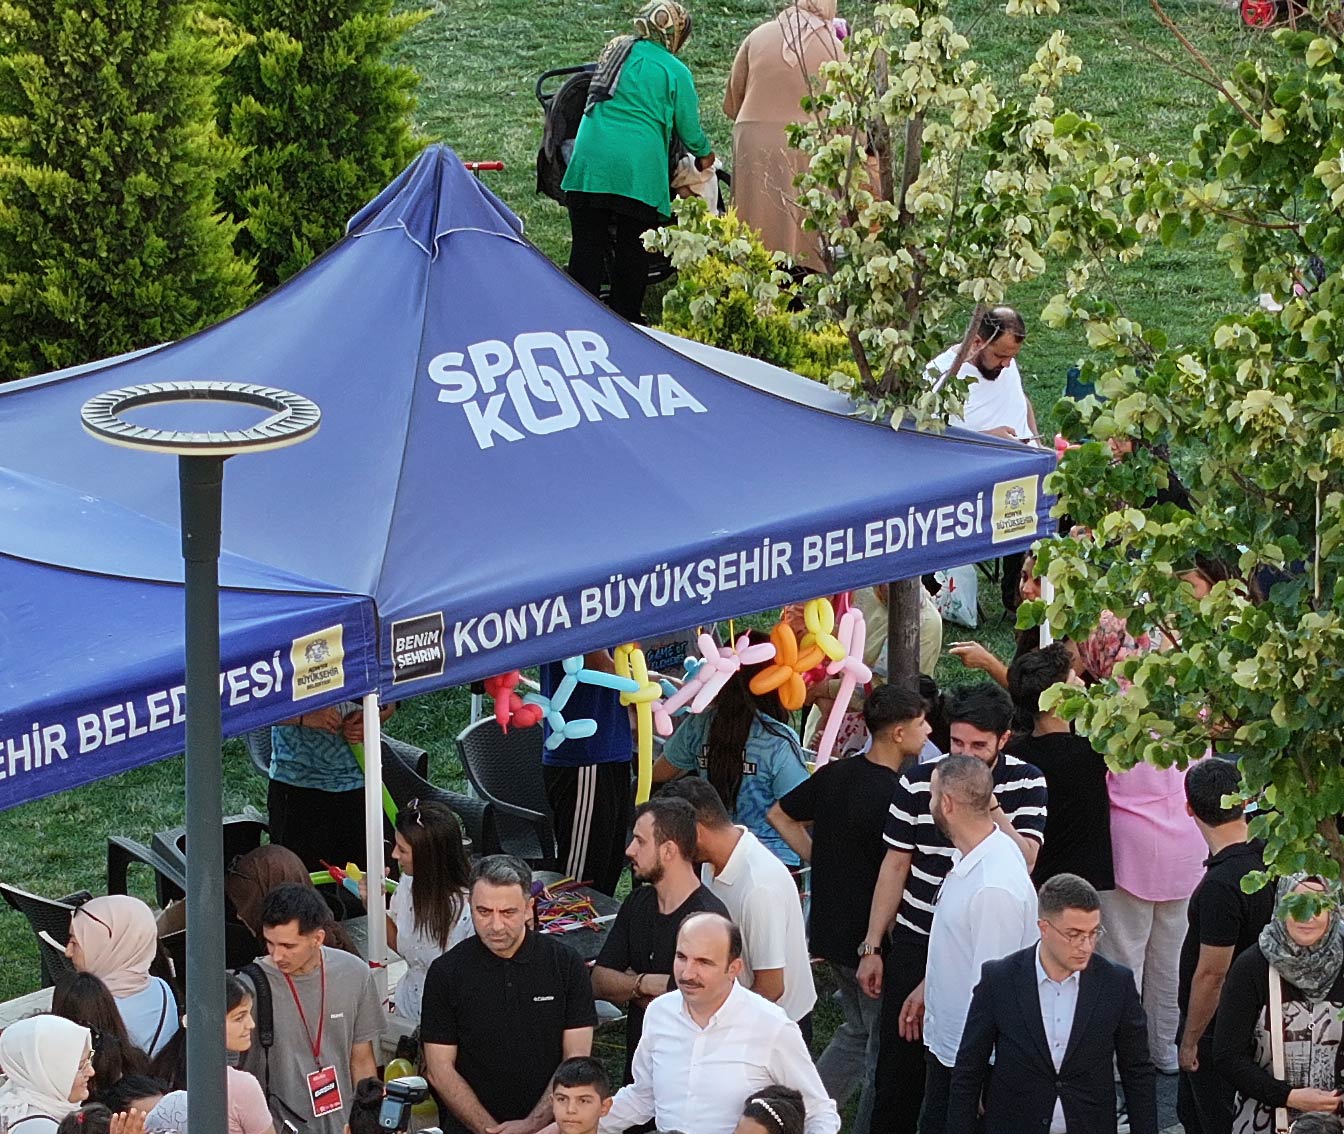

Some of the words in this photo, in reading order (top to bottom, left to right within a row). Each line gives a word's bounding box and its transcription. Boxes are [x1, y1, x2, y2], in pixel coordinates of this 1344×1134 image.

[427, 331, 621, 402] SPOR
[463, 366, 708, 450] KONYA
[453, 595, 573, 657] KONYA
[580, 537, 793, 625] BÜYÜKŞEHİR
[803, 492, 983, 572] BELEDİYESİ
[77, 651, 284, 754] BELEDESİ
